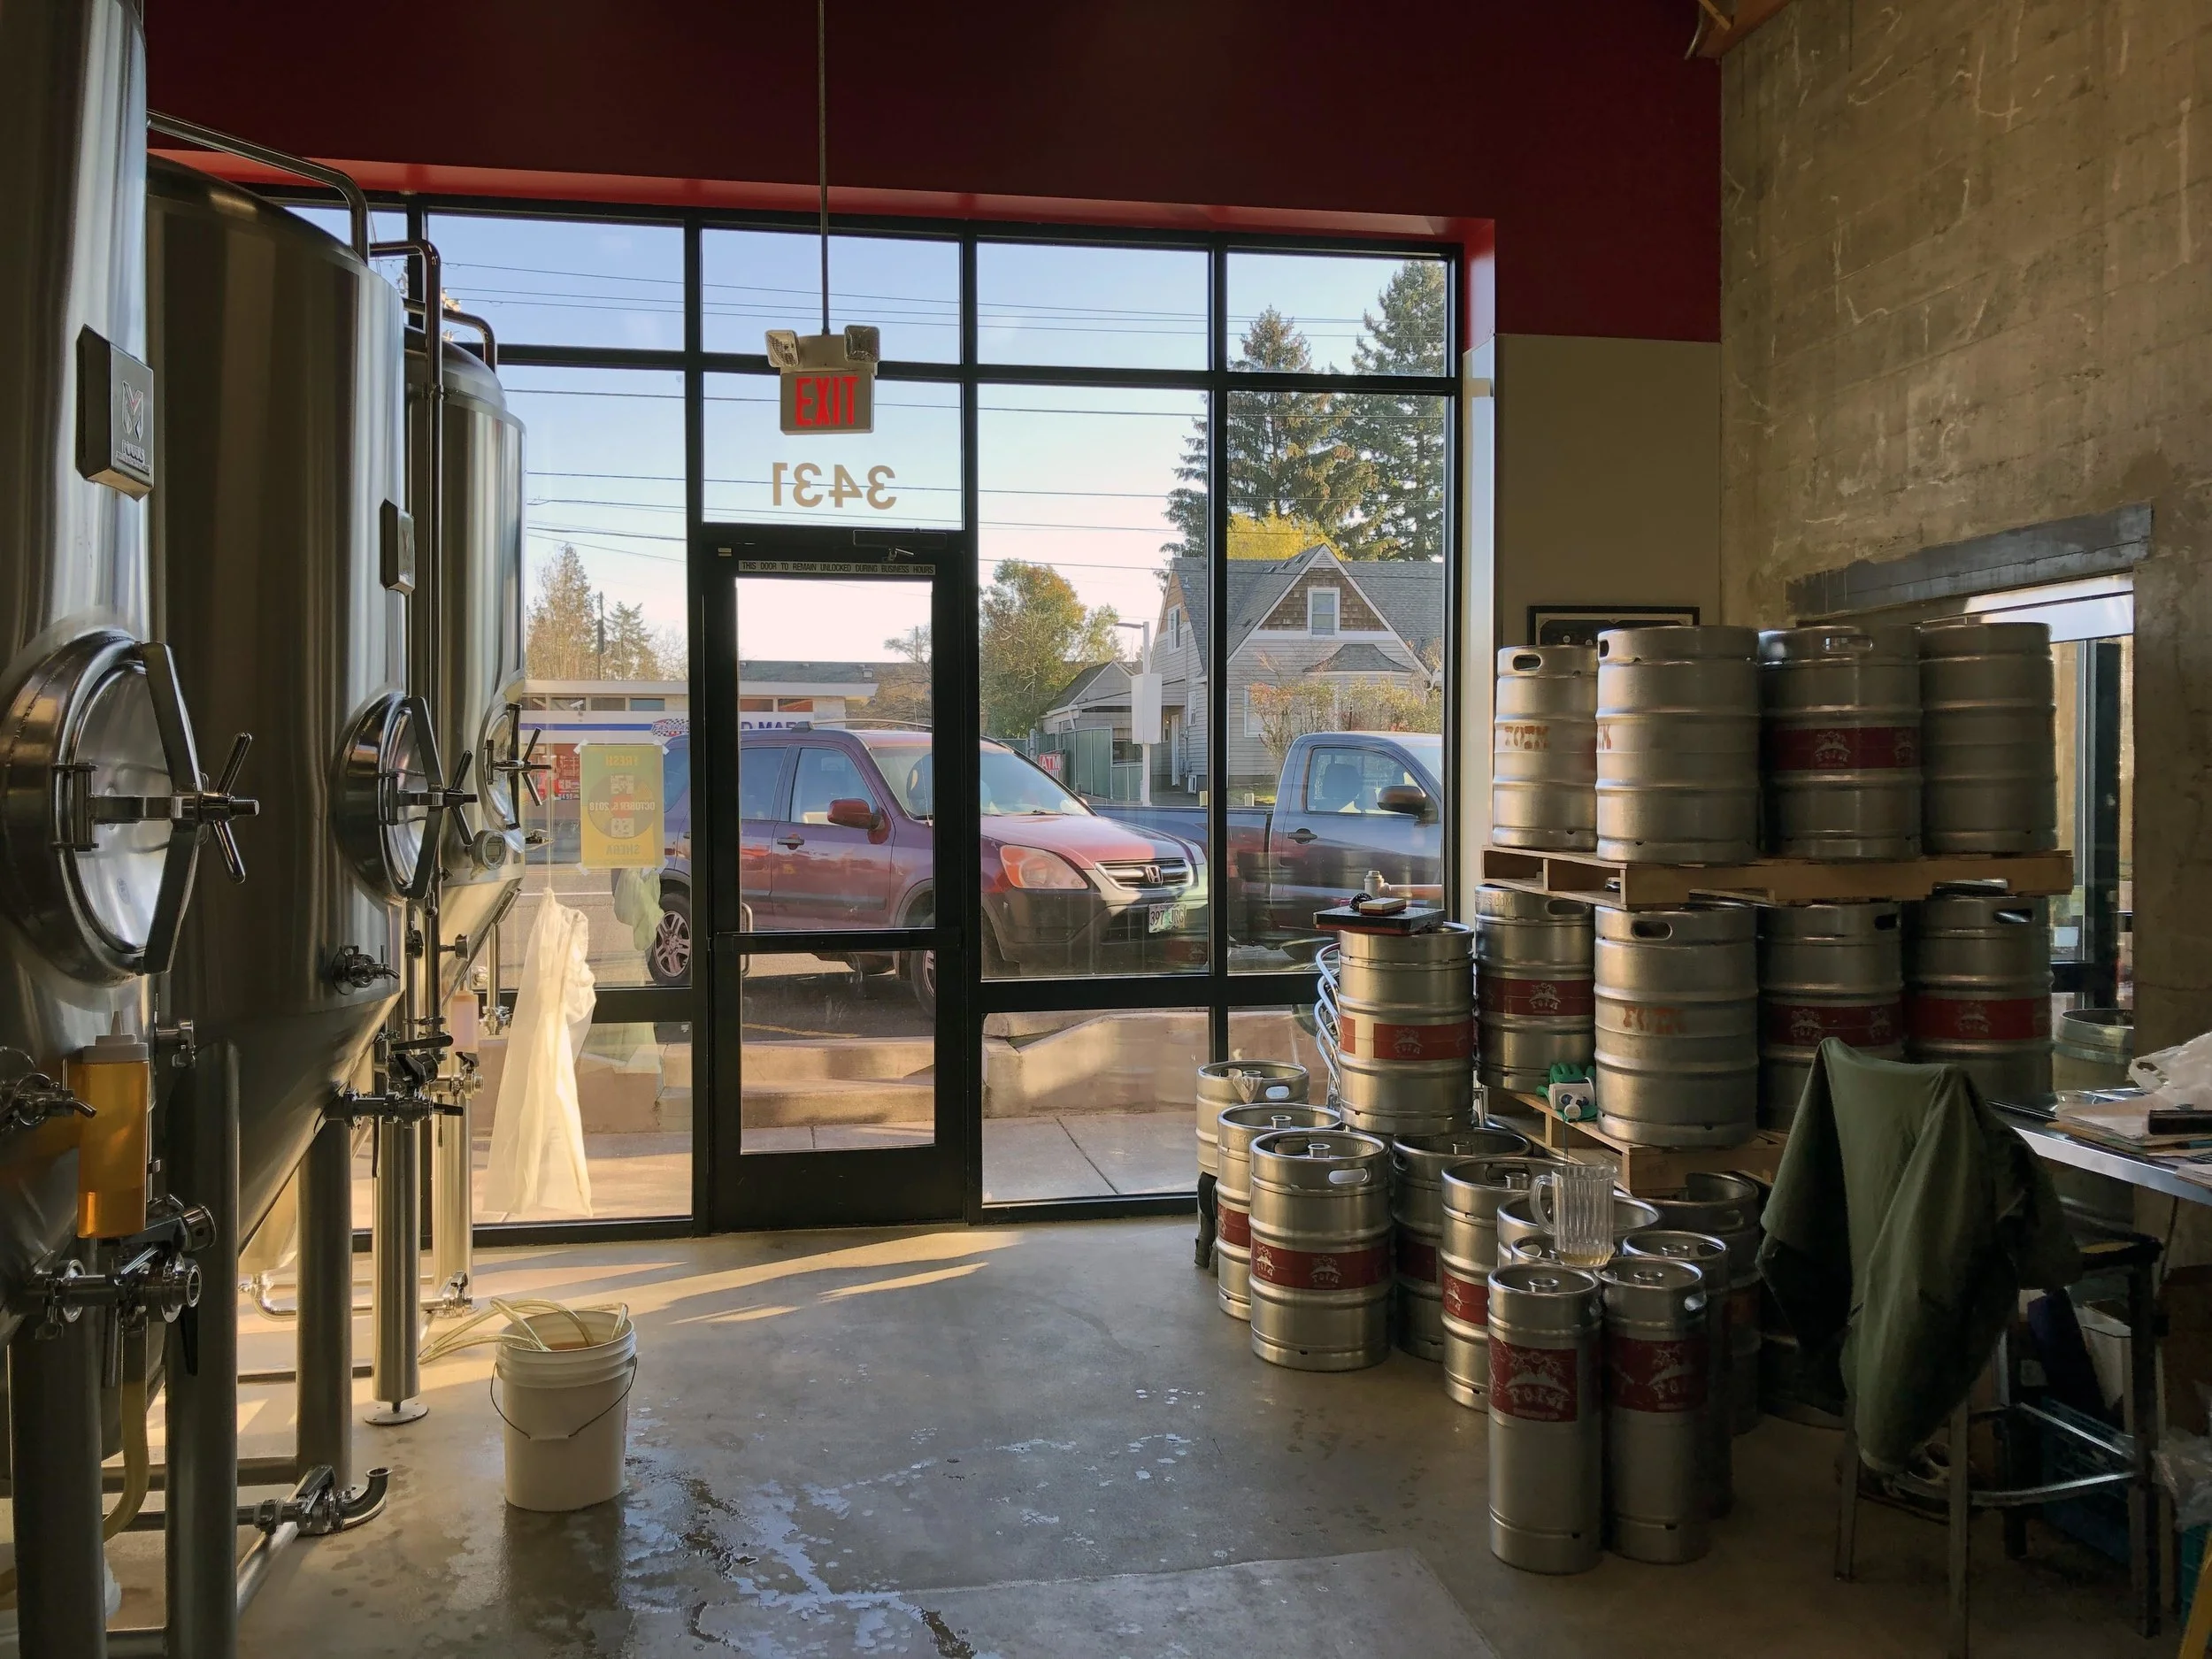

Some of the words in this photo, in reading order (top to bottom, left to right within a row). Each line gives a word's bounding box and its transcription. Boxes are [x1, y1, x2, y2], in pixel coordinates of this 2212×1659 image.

[795, 375, 860, 426] EXIT
[760, 562, 777, 571] DOOR
[793, 563, 817, 572] REMAIN
[820, 564, 851, 572] UNLOCKED
[913, 565, 933, 574] HOURS
[1041, 756, 1061, 770] ATM
[1150, 910, 1165, 926] 397
